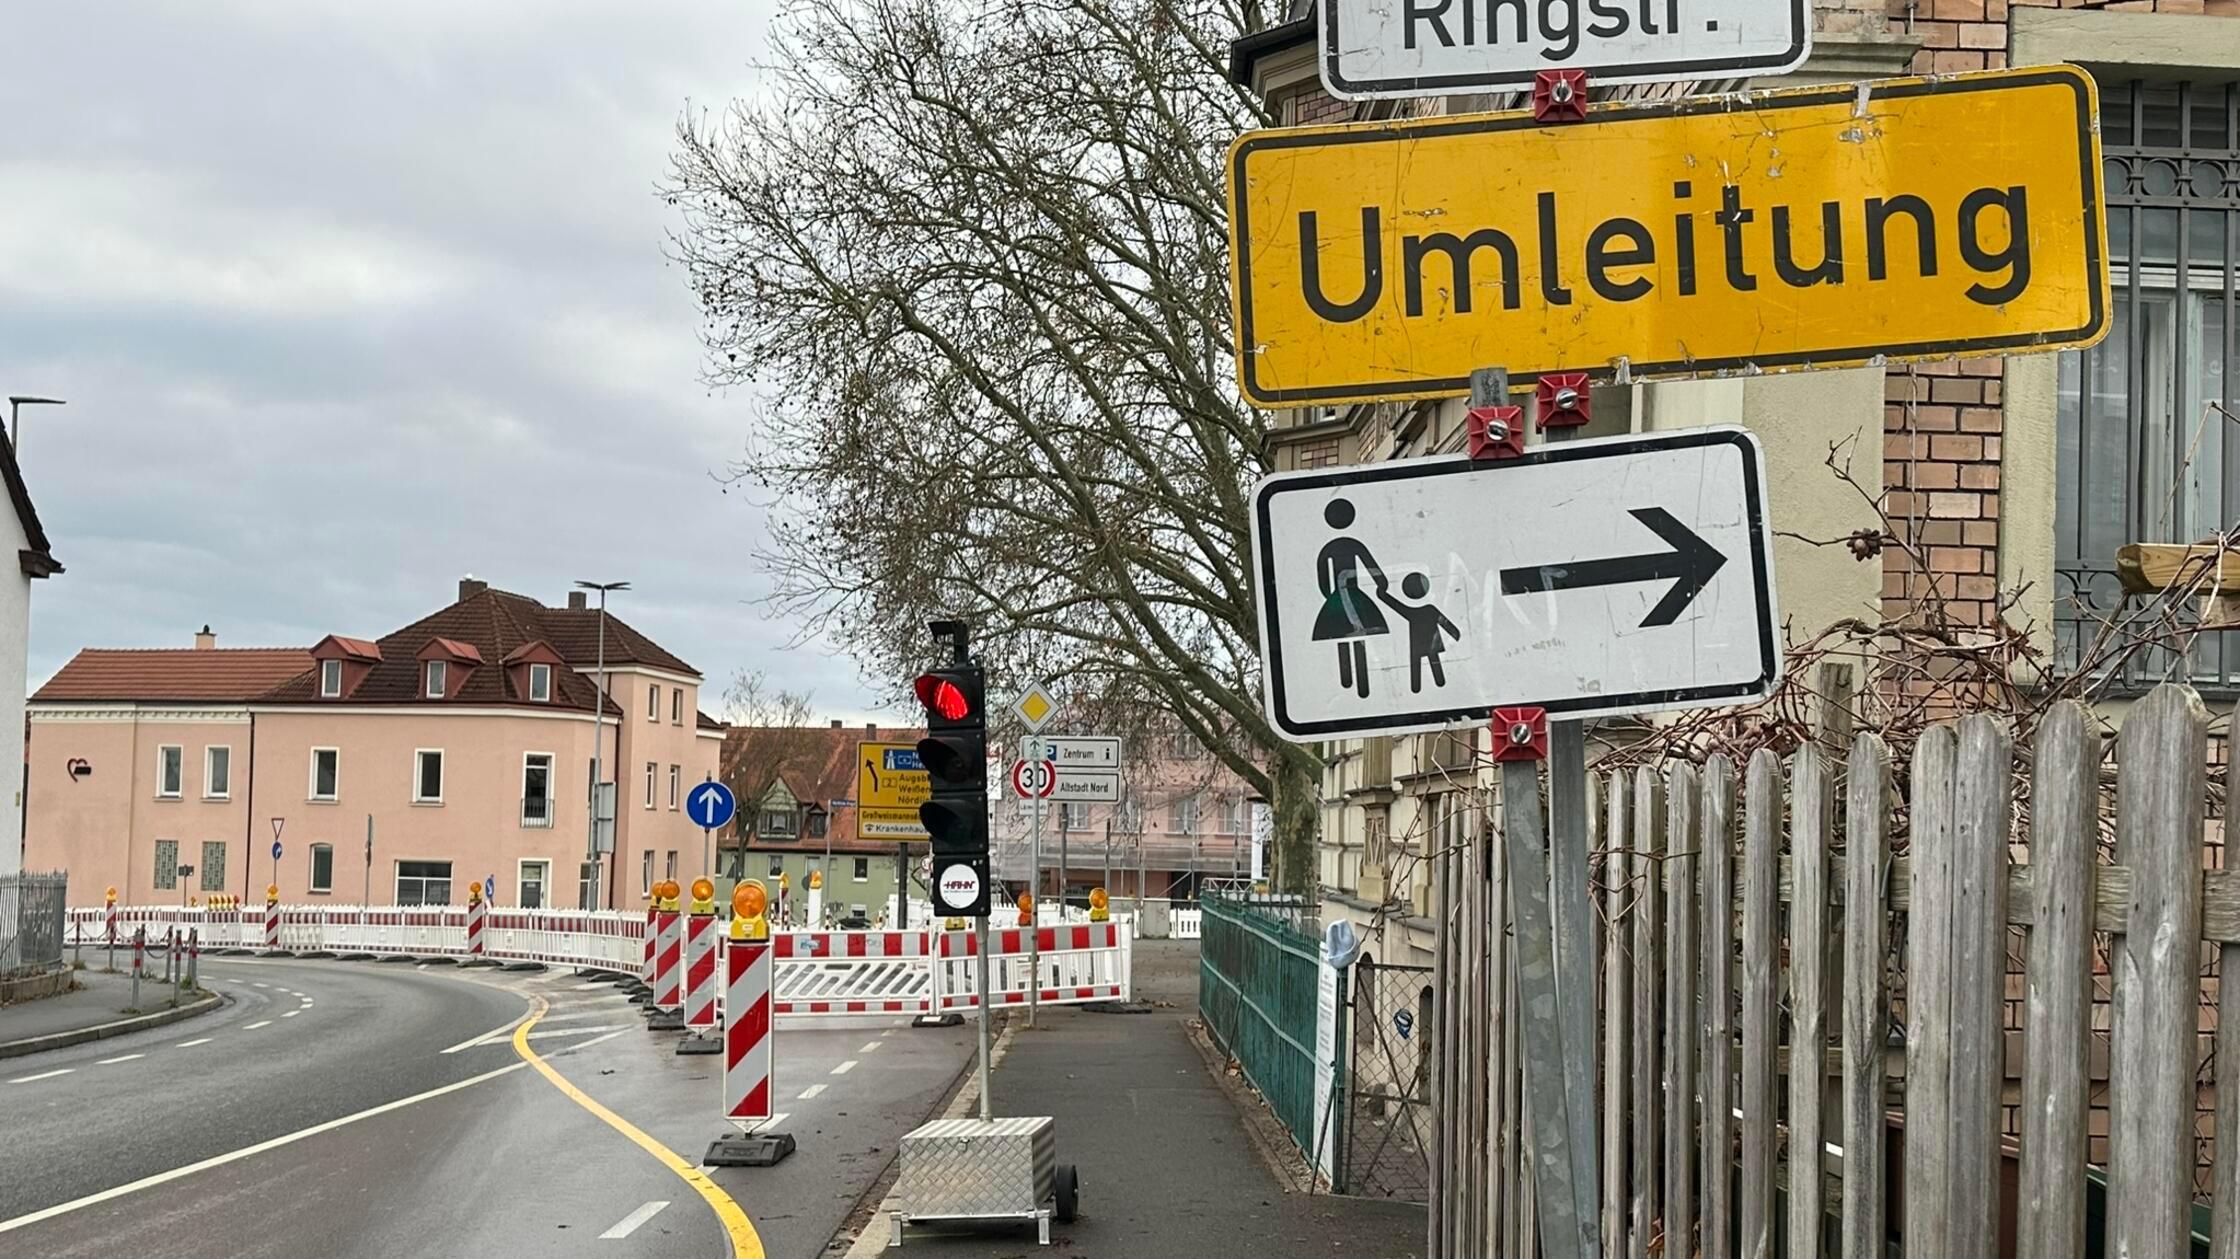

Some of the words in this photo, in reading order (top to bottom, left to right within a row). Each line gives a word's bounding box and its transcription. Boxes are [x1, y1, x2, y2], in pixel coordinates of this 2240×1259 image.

[1298, 180, 2031, 324] Umleitung
[1063, 748, 1094, 759] Zentrum
[899, 773, 930, 783] Augsb
[1022, 768, 1047, 788] 30
[1060, 782, 1089, 793] Altstadt
[1090, 782, 1109, 793] Nord
